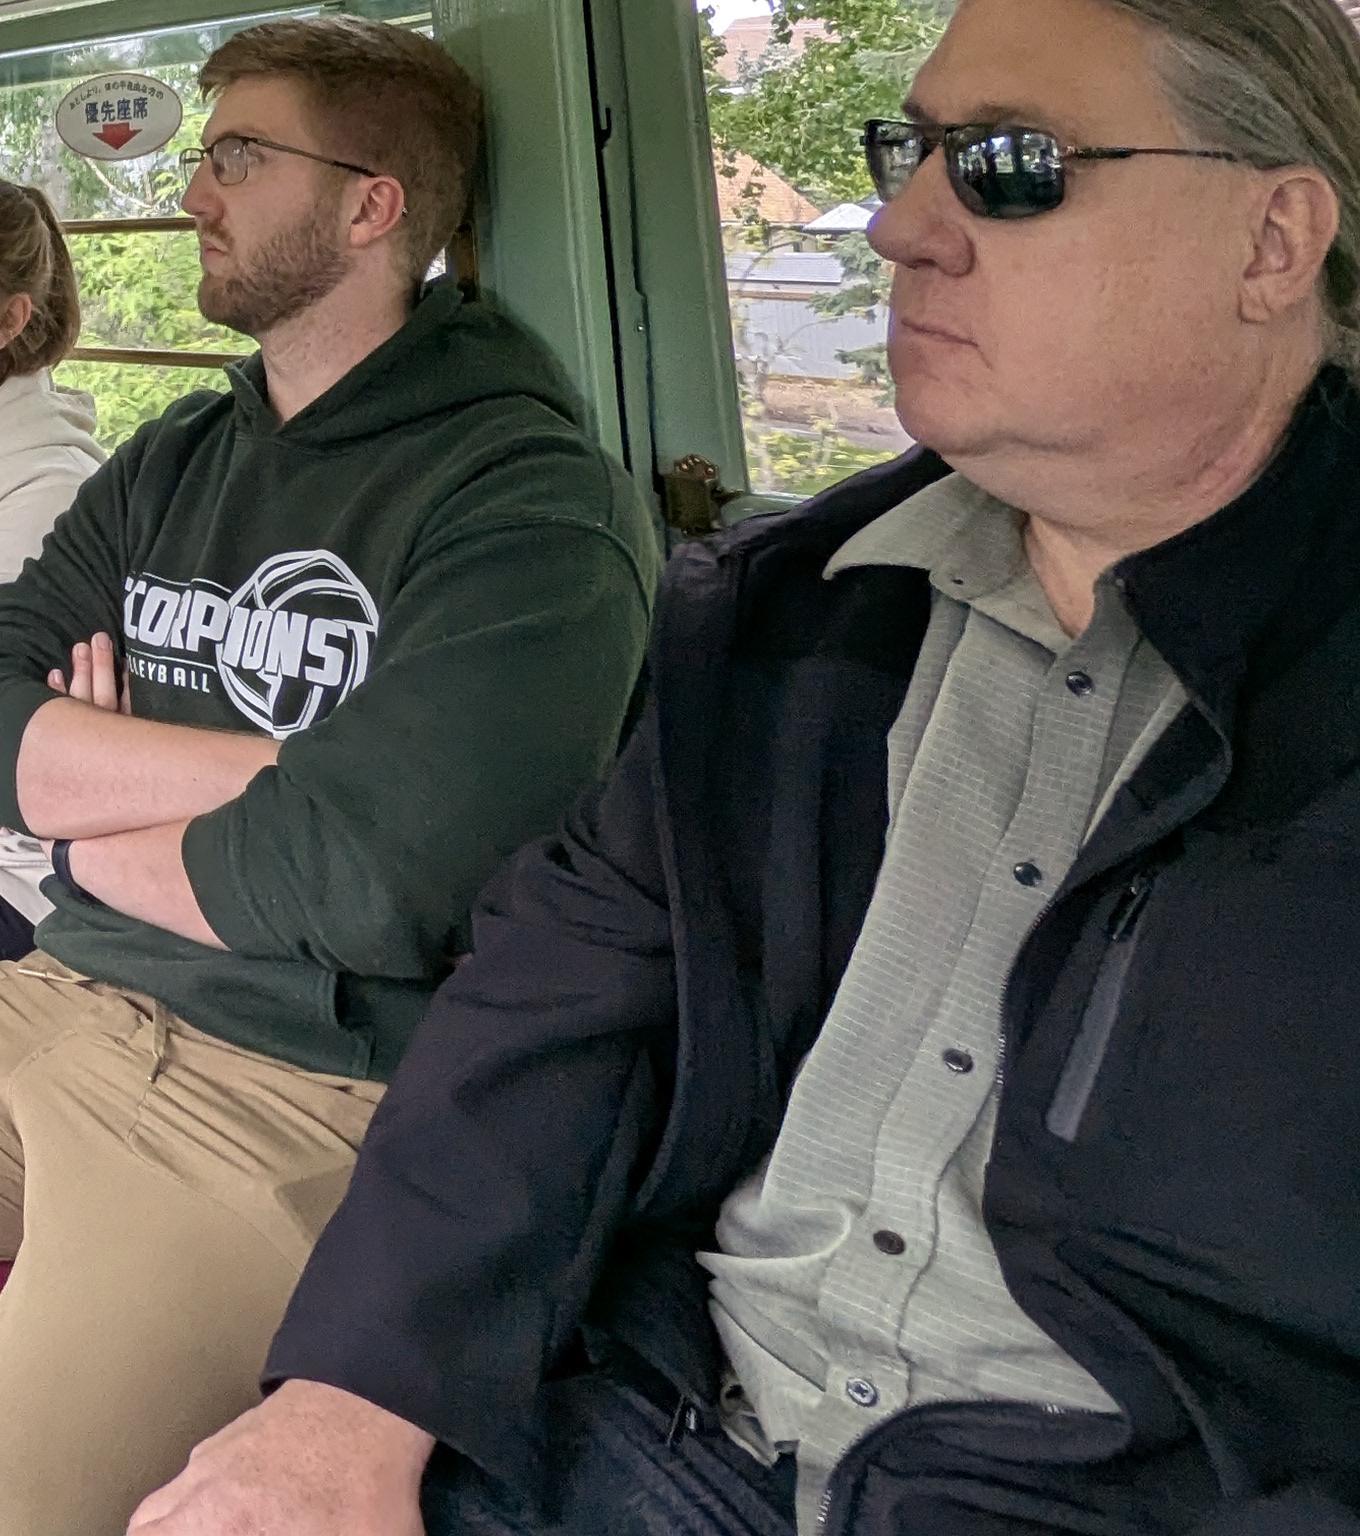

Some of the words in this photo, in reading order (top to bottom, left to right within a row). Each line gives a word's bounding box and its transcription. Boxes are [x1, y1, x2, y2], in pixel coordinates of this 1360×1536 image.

[85, 96, 148, 124] 優先座席
[123, 575, 348, 687] CORPIONS
[126, 652, 211, 693] LLEYBALL
